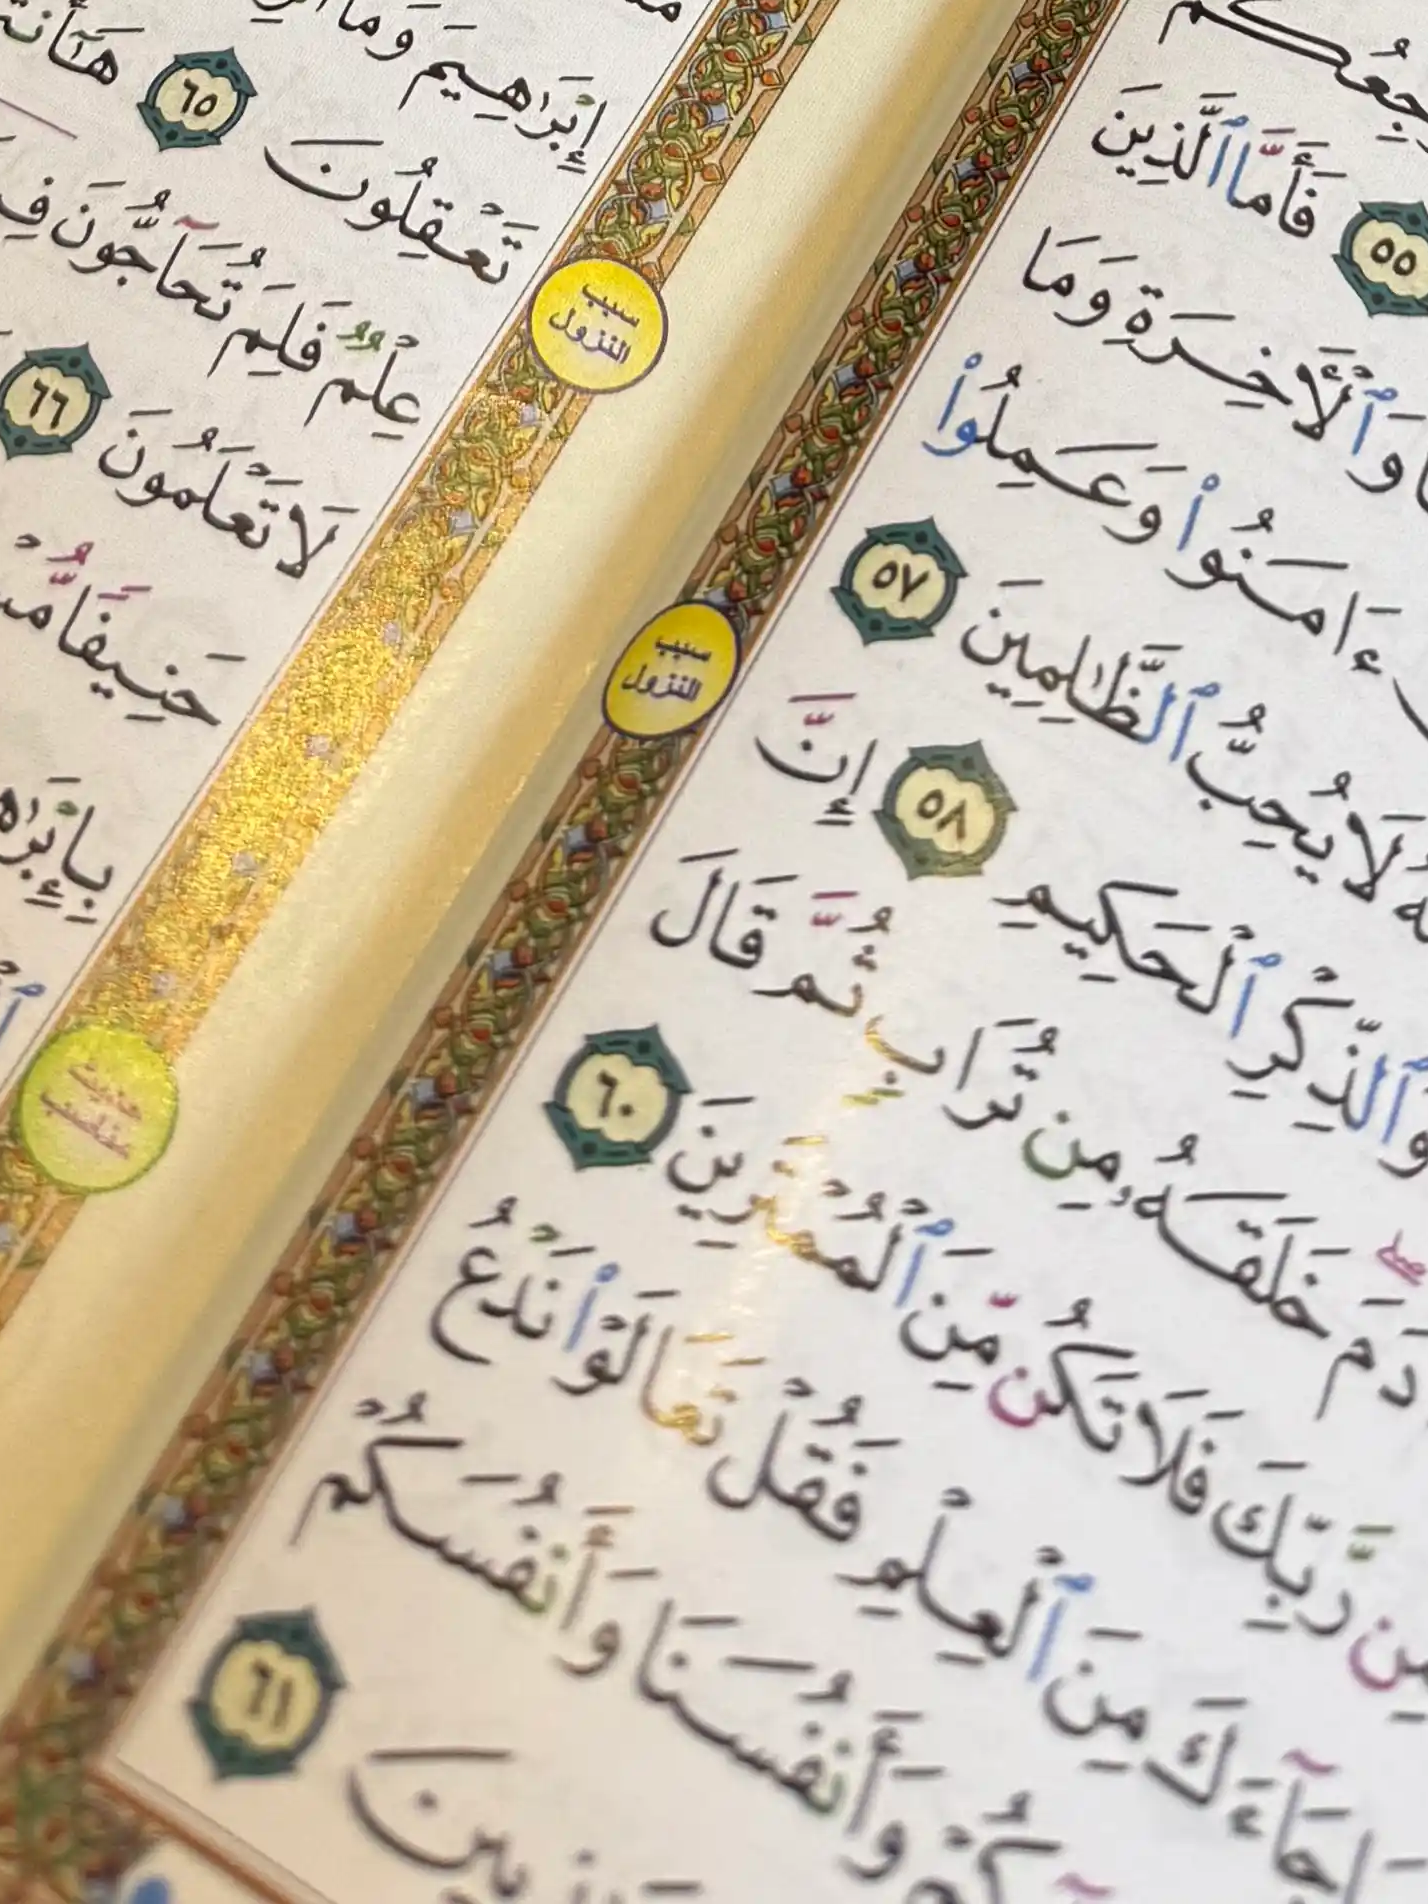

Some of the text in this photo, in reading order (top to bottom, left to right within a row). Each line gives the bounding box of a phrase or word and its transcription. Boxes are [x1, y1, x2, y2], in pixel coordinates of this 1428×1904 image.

[577, 276, 643, 330] سبب
[549, 307, 631, 366] النزول
[654, 631, 713, 666] سبب
[620, 661, 702, 705] النزول
